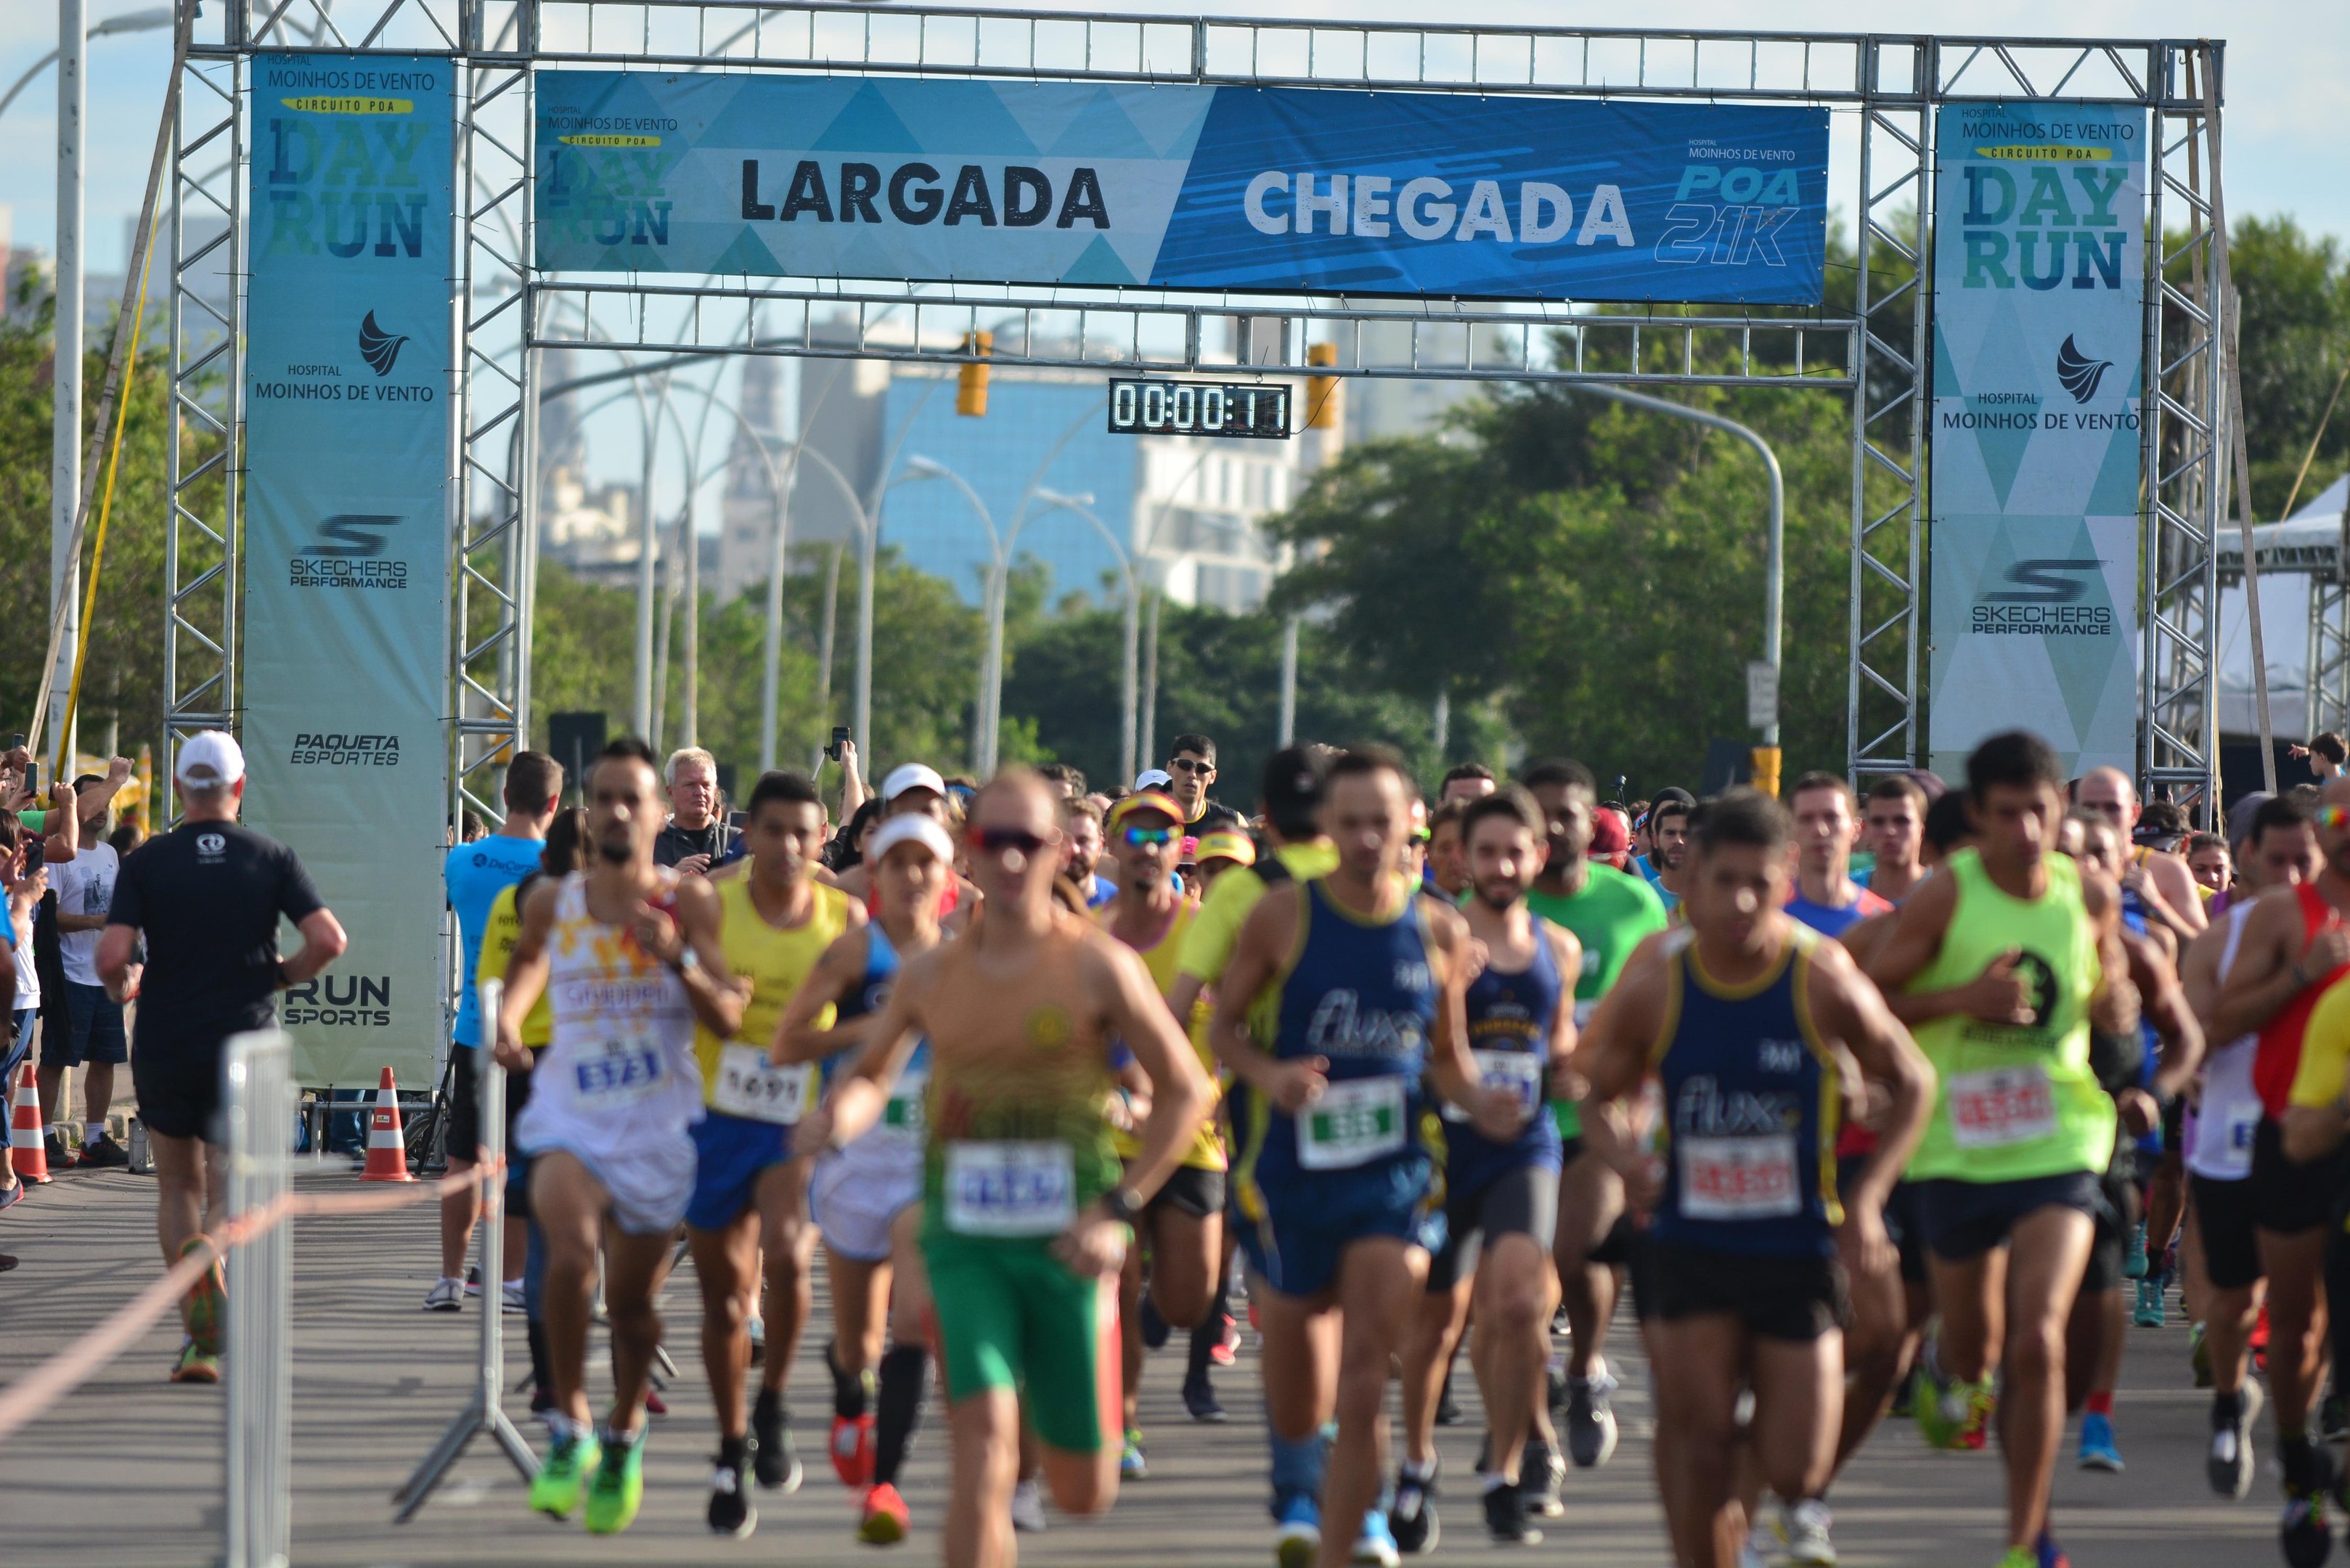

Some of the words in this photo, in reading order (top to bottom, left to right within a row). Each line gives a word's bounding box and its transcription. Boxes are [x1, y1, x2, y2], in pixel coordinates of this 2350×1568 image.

[267, 54, 312, 66] HOSPITAL
[268, 70, 350, 89] MOINHOS
[354, 72, 375, 89] DE
[380, 73, 435, 91] VENTO
[296, 99, 361, 111] CIRCUITO
[370, 101, 394, 112] POA
[547, 106, 581, 115] HOSPITAL
[1961, 108, 2007, 118] HOSPITAL
[548, 117, 611, 129] MOINHOS
[614, 118, 632, 130] DE
[635, 118, 678, 131] VENTO
[1962, 122, 2046, 139] MOINHOS
[2050, 123, 2073, 139] DE
[2077, 123, 2134, 140] VENTO
[269, 118, 431, 187] DAY
[1689, 147, 1742, 160] MOINHOS
[1744, 149, 1758, 160] DE
[1760, 150, 1796, 161] VENTO
[1991, 148, 2058, 159] CIRCUITO
[2067, 149, 2092, 159] POA
[548, 150, 674, 197] DAY
[741, 159, 1111, 229] LARGADA
[1674, 165, 1800, 205] POA
[1963, 166, 2129, 226] DAY
[1244, 170, 1636, 247] CHEGADA
[267, 189, 428, 258] RUN
[548, 199, 673, 245] RUN
[1655, 203, 1801, 266] 21K
[1962, 230, 2128, 291] RUN
[287, 364, 342, 376] HOSPITAL
[256, 383, 342, 400] MOINHOS
[347, 385, 370, 401] DE
[375, 385, 434, 402] VENTO
[1978, 393, 2038, 404] HOSPITAL
[1114, 384, 1286, 430] 00:00:11
[1943, 412, 2038, 430] MOINHOS
[2044, 414, 2068, 430] DE
[2075, 414, 2140, 430] VENTO
[290, 559, 407, 577] SKECHERS
[290, 576, 407, 589] PERFORMANCE
[1972, 606, 2110, 623] SKECHERS
[1972, 624, 2110, 635] PERFORMANCE
[290, 751, 399, 766] ESPORTES
[285, 975, 391, 1007] RUN
[284, 1008, 391, 1026] SPORTS
